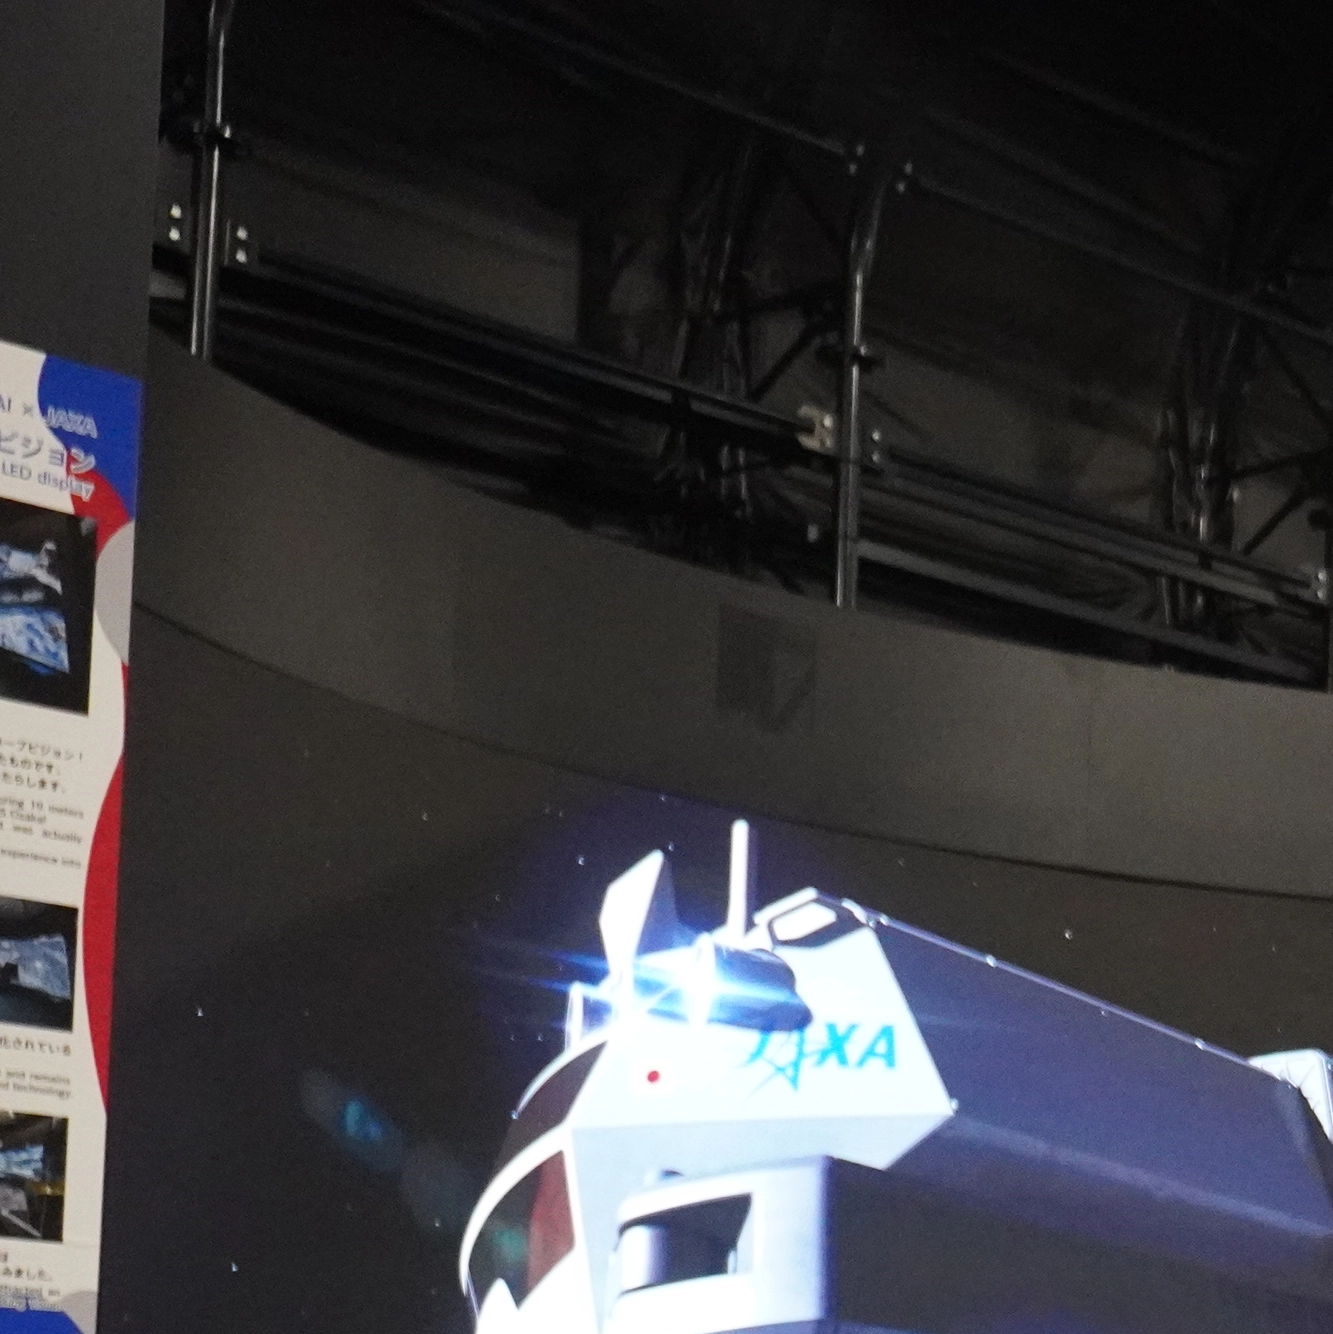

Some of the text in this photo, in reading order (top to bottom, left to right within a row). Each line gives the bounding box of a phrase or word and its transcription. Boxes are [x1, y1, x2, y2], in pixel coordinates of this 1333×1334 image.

[45, 405, 98, 439] JAXA
[2, 458, 95, 502] LED display
